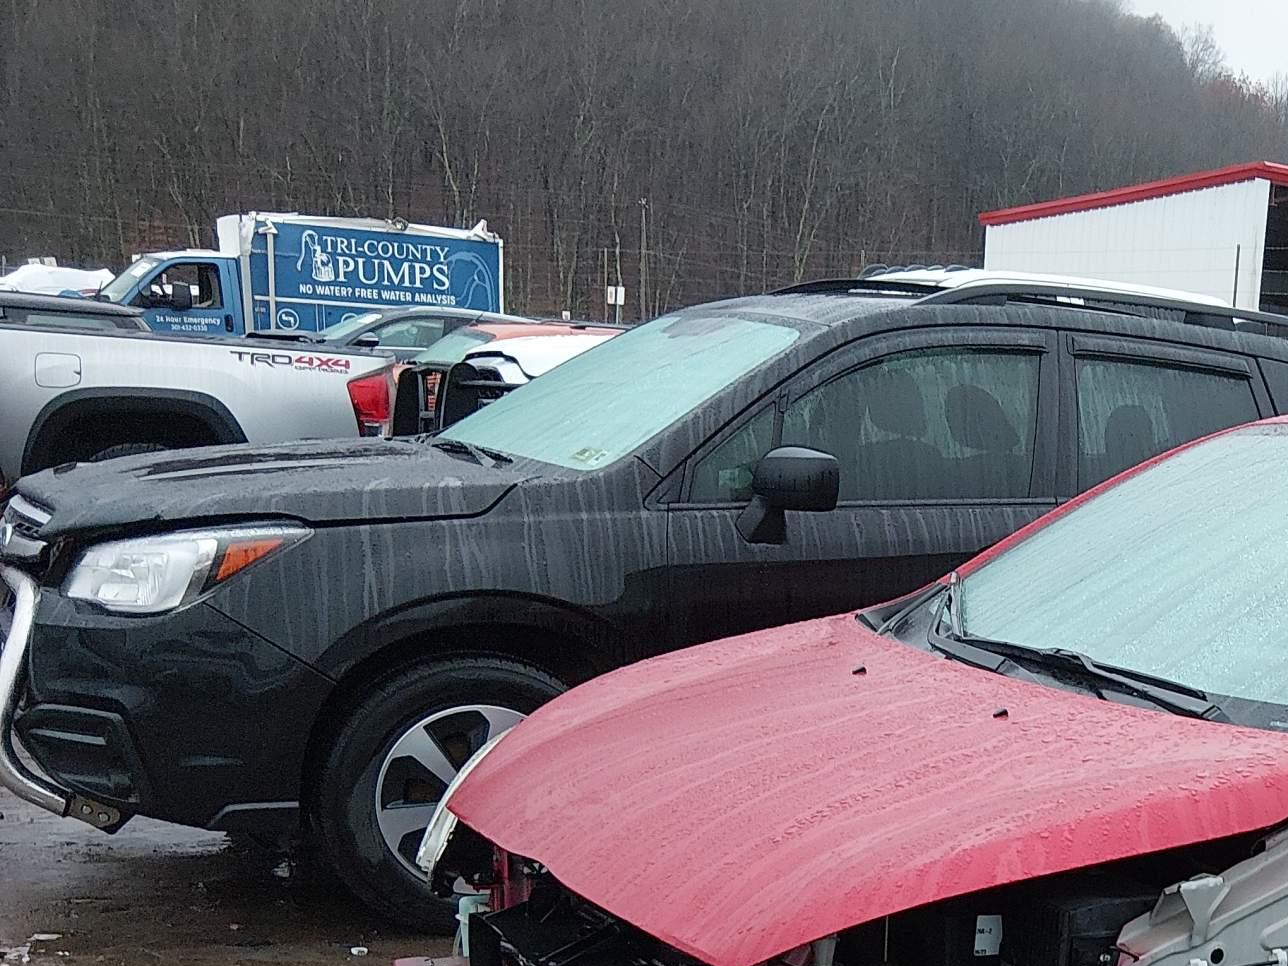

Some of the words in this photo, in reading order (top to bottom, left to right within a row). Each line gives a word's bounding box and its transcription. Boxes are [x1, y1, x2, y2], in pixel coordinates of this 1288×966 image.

[323, 235, 449, 262] TRI-COUNTY
[336, 255, 449, 290] PUMPS
[300, 284, 313, 294] NO
[315, 285, 352, 297] WATER?
[355, 287, 379, 299] FREE
[381, 289, 413, 302] WATER
[414, 292, 456, 305] ANALYSIS
[183, 316, 221, 326] Emergency
[229, 350, 294, 368] TRD
